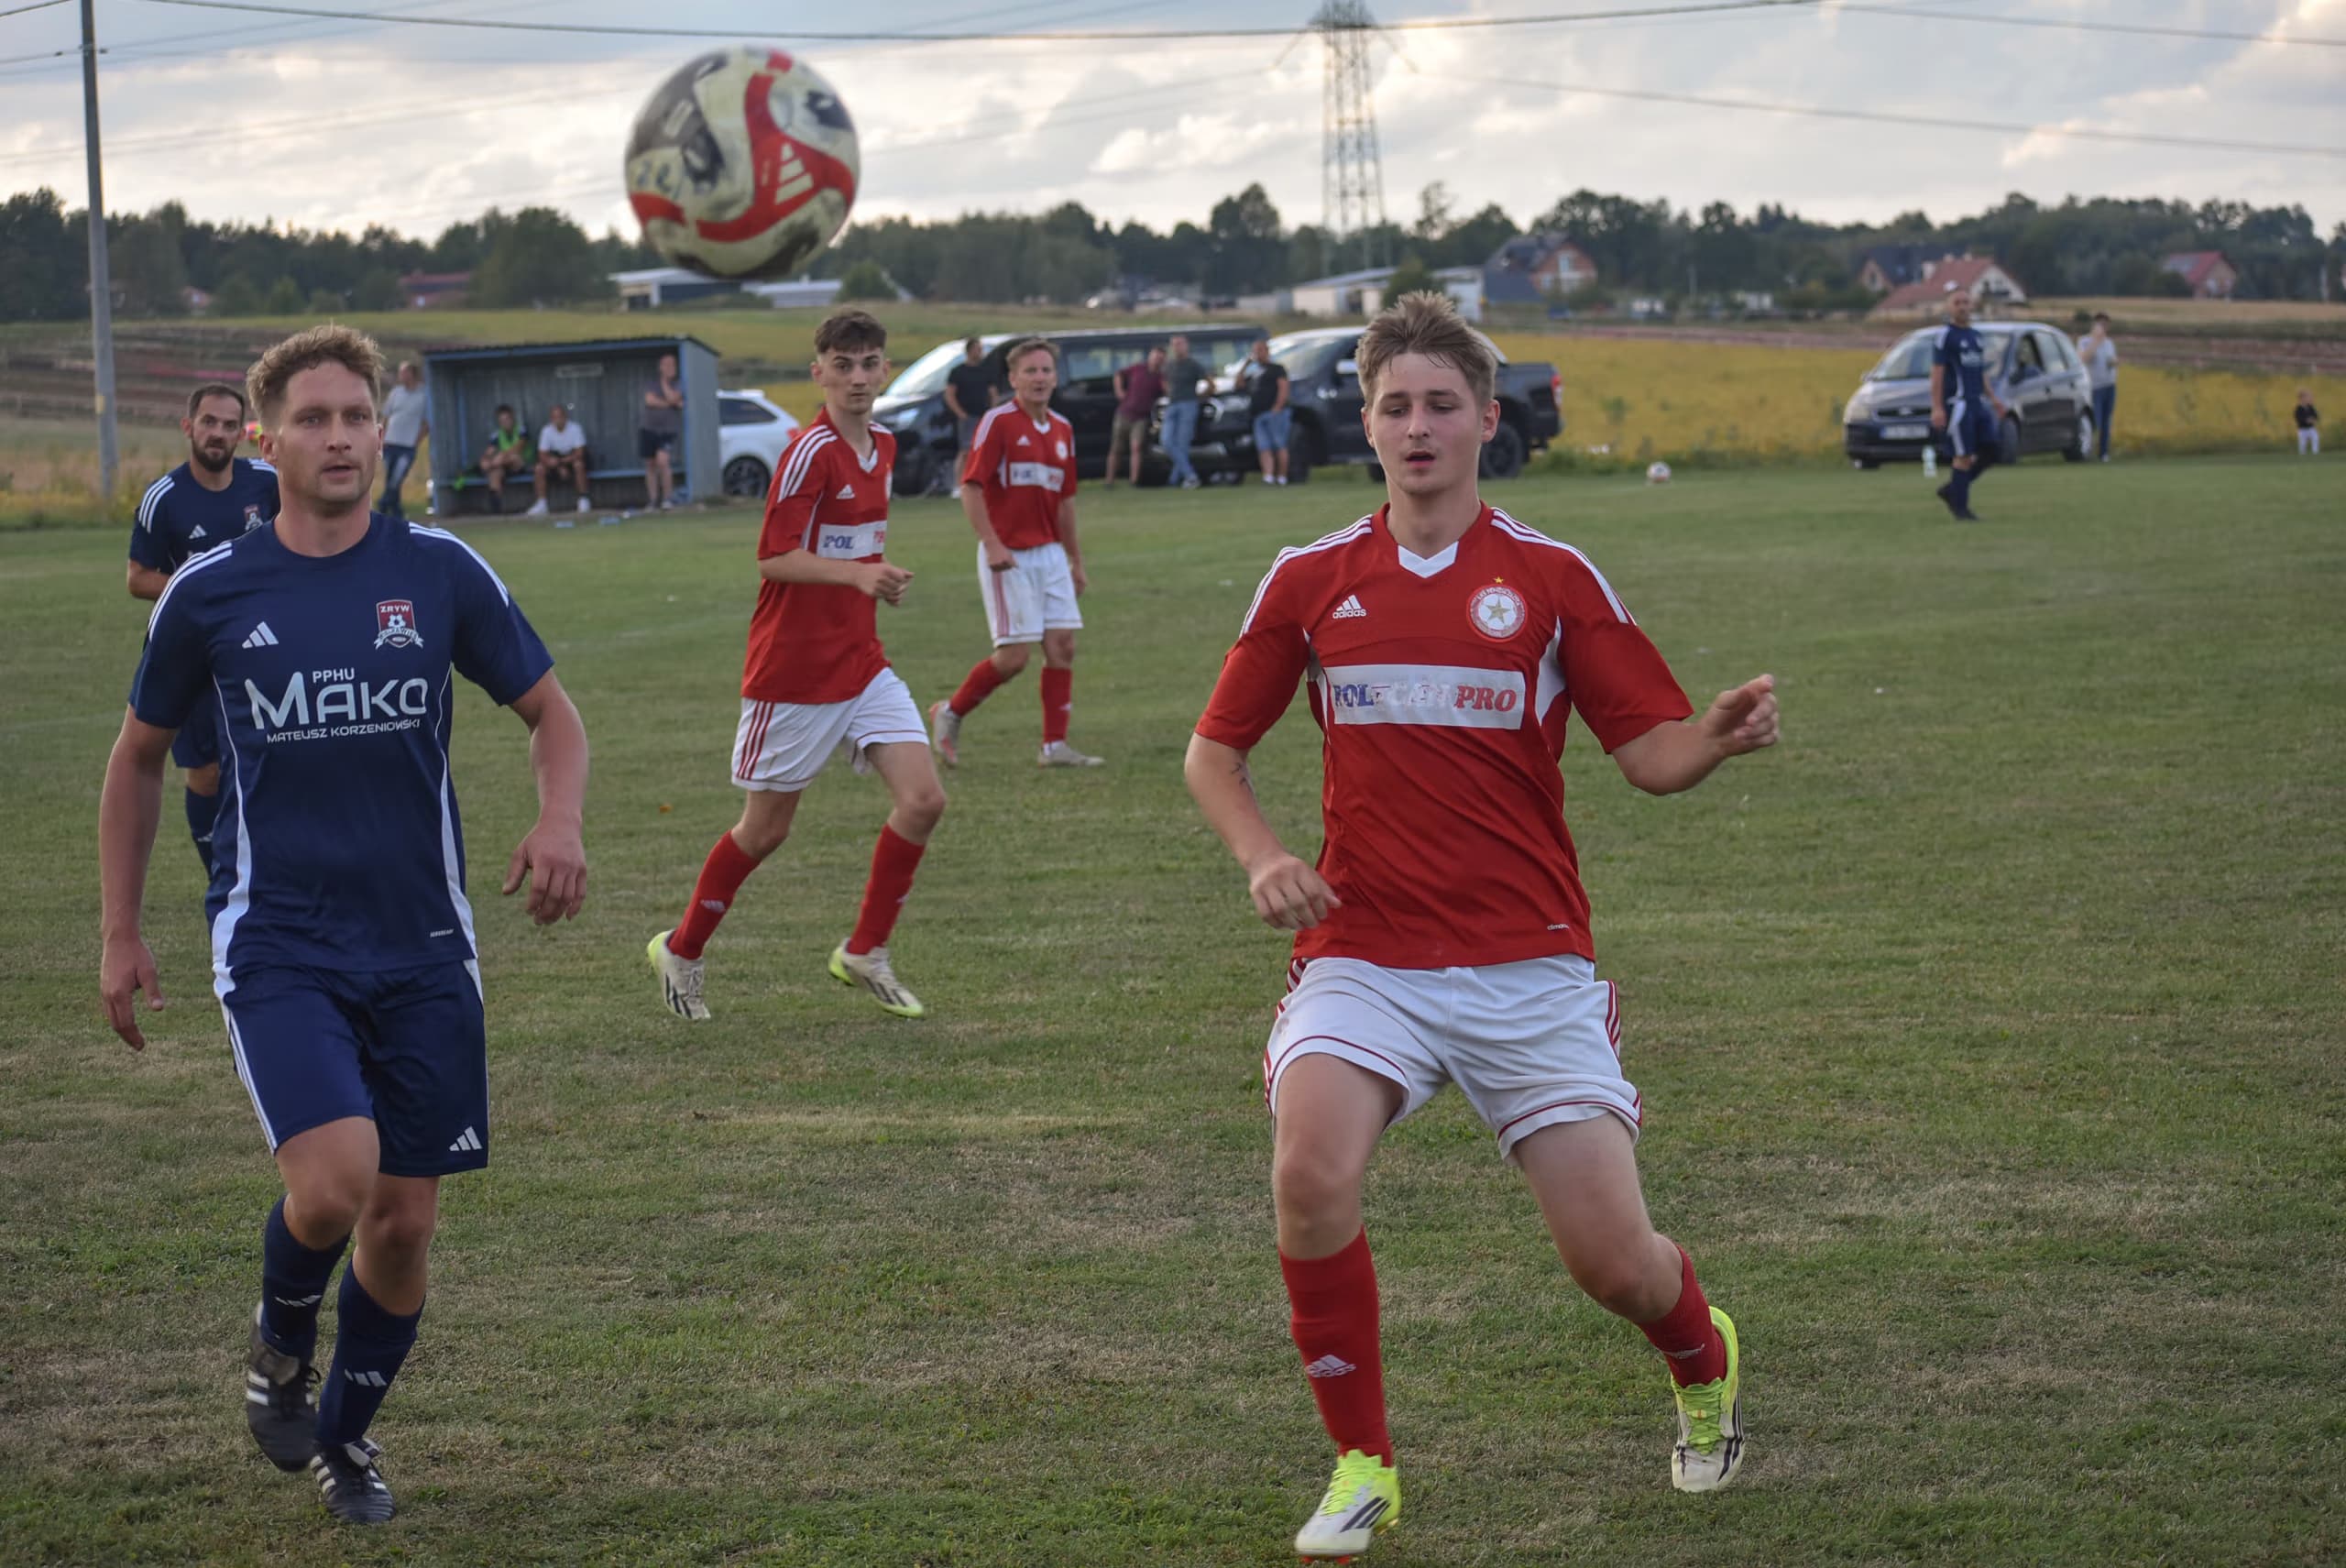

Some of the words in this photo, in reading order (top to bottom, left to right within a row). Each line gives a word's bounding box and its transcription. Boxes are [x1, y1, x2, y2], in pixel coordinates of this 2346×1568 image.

[379, 605, 411, 613] ZRYW
[1332, 608, 1366, 620] adidas
[312, 667, 356, 684] PPHU
[244, 671, 429, 730] MAKO
[1453, 685, 1518, 712] PRO
[266, 727, 328, 744] MATEUSZ
[330, 718, 422, 738] KORZENIOWSKI
